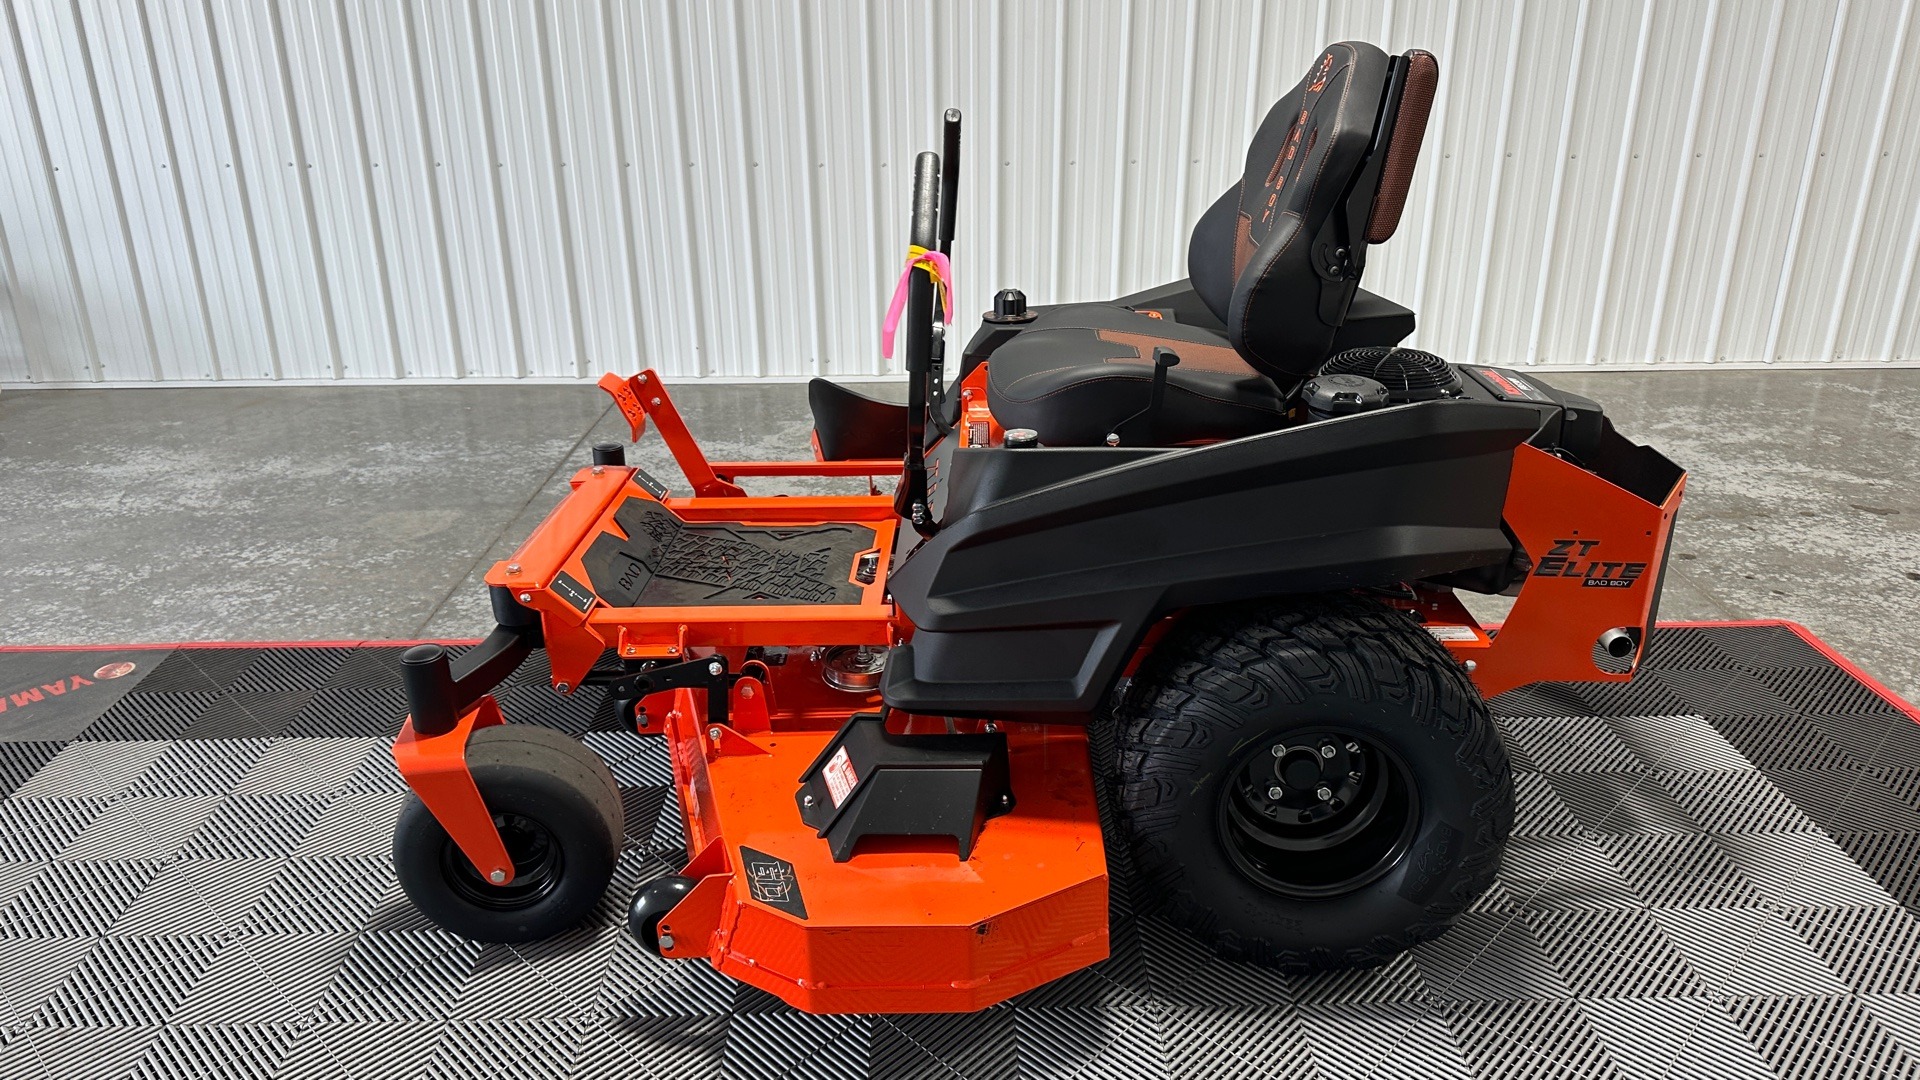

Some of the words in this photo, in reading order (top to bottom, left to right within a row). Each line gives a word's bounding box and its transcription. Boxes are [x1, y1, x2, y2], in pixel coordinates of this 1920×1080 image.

[1547, 539, 1600, 556] ZT
[618, 562, 642, 591] BAD
[1533, 556, 1648, 578] ELITE
